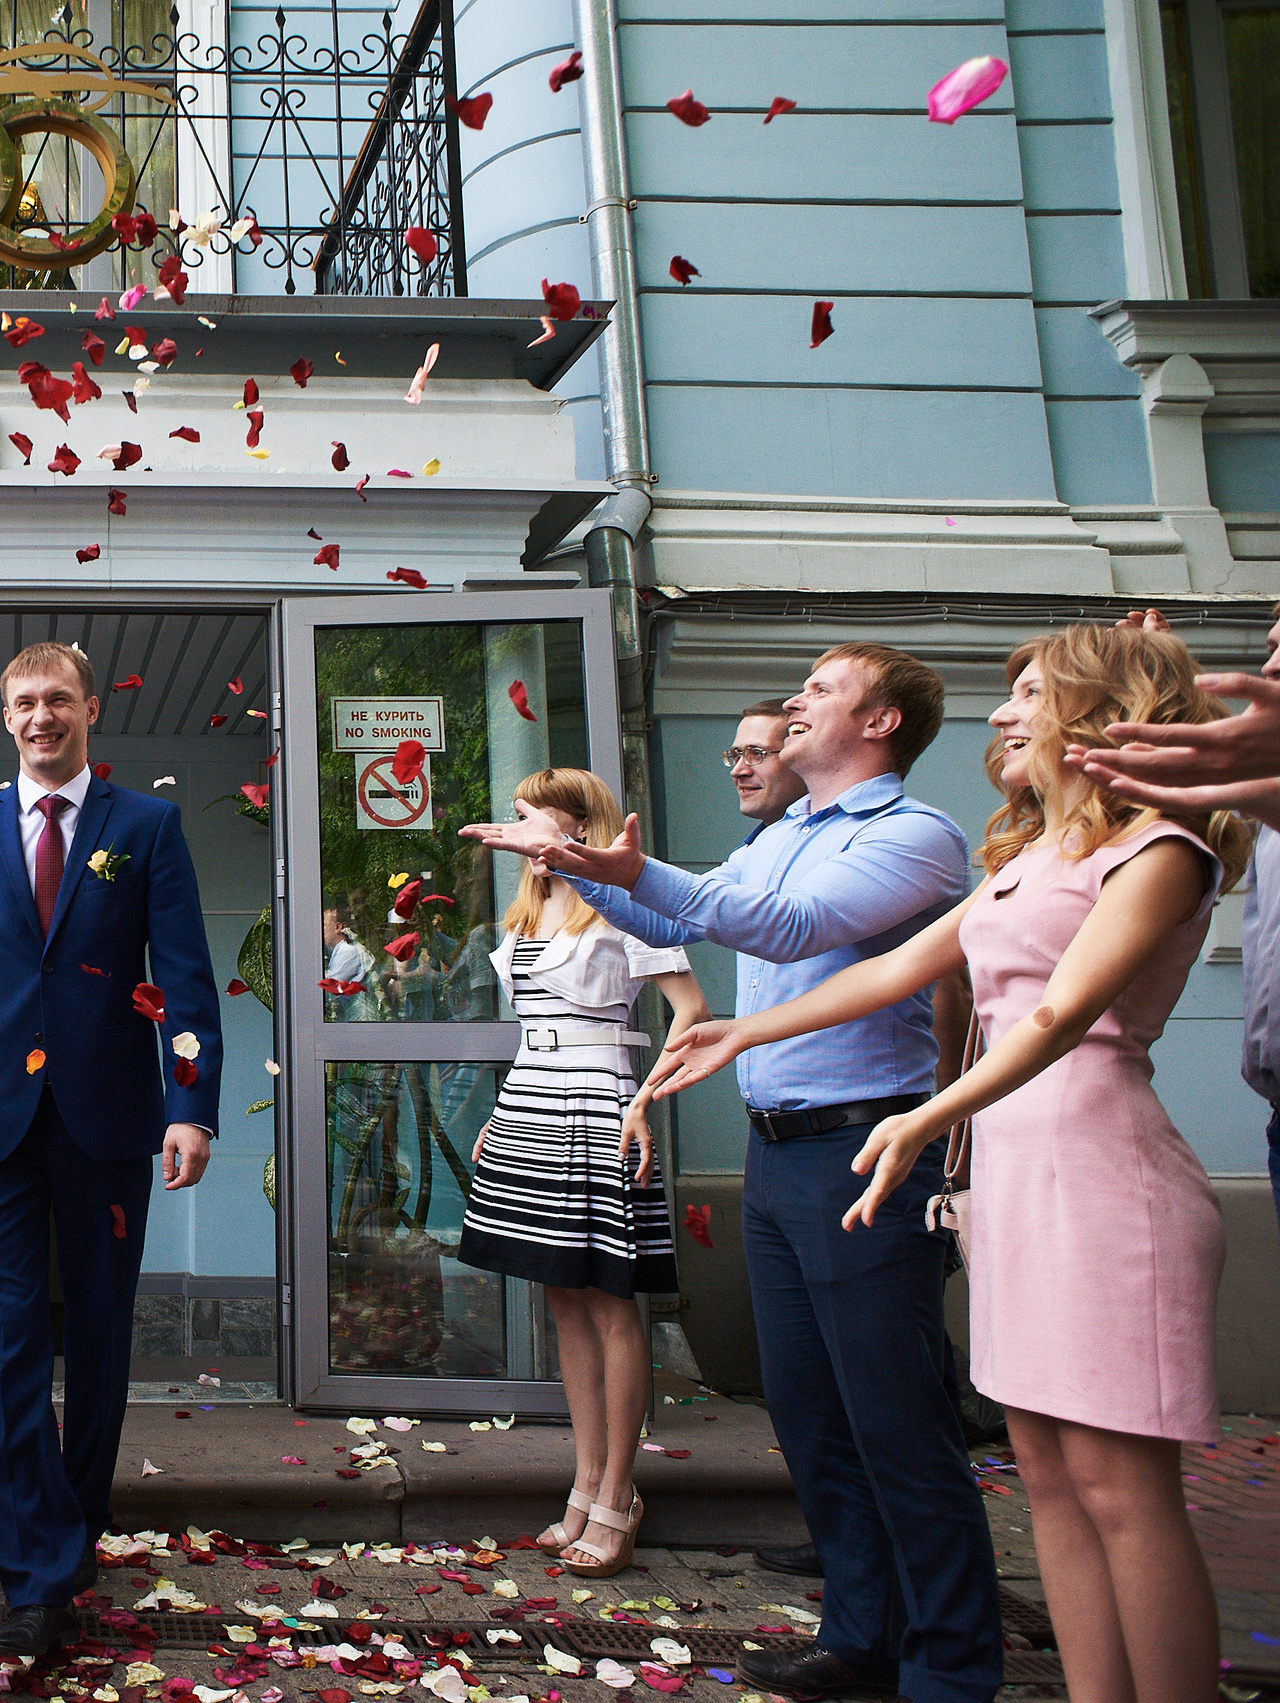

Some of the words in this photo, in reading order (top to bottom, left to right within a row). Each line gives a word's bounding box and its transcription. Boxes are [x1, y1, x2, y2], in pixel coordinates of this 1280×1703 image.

[351, 711, 368, 721] НЕ
[376, 711, 424, 721] КУРИТЬ
[345, 728, 364, 738] NO
[372, 727, 431, 738] SMOKING
